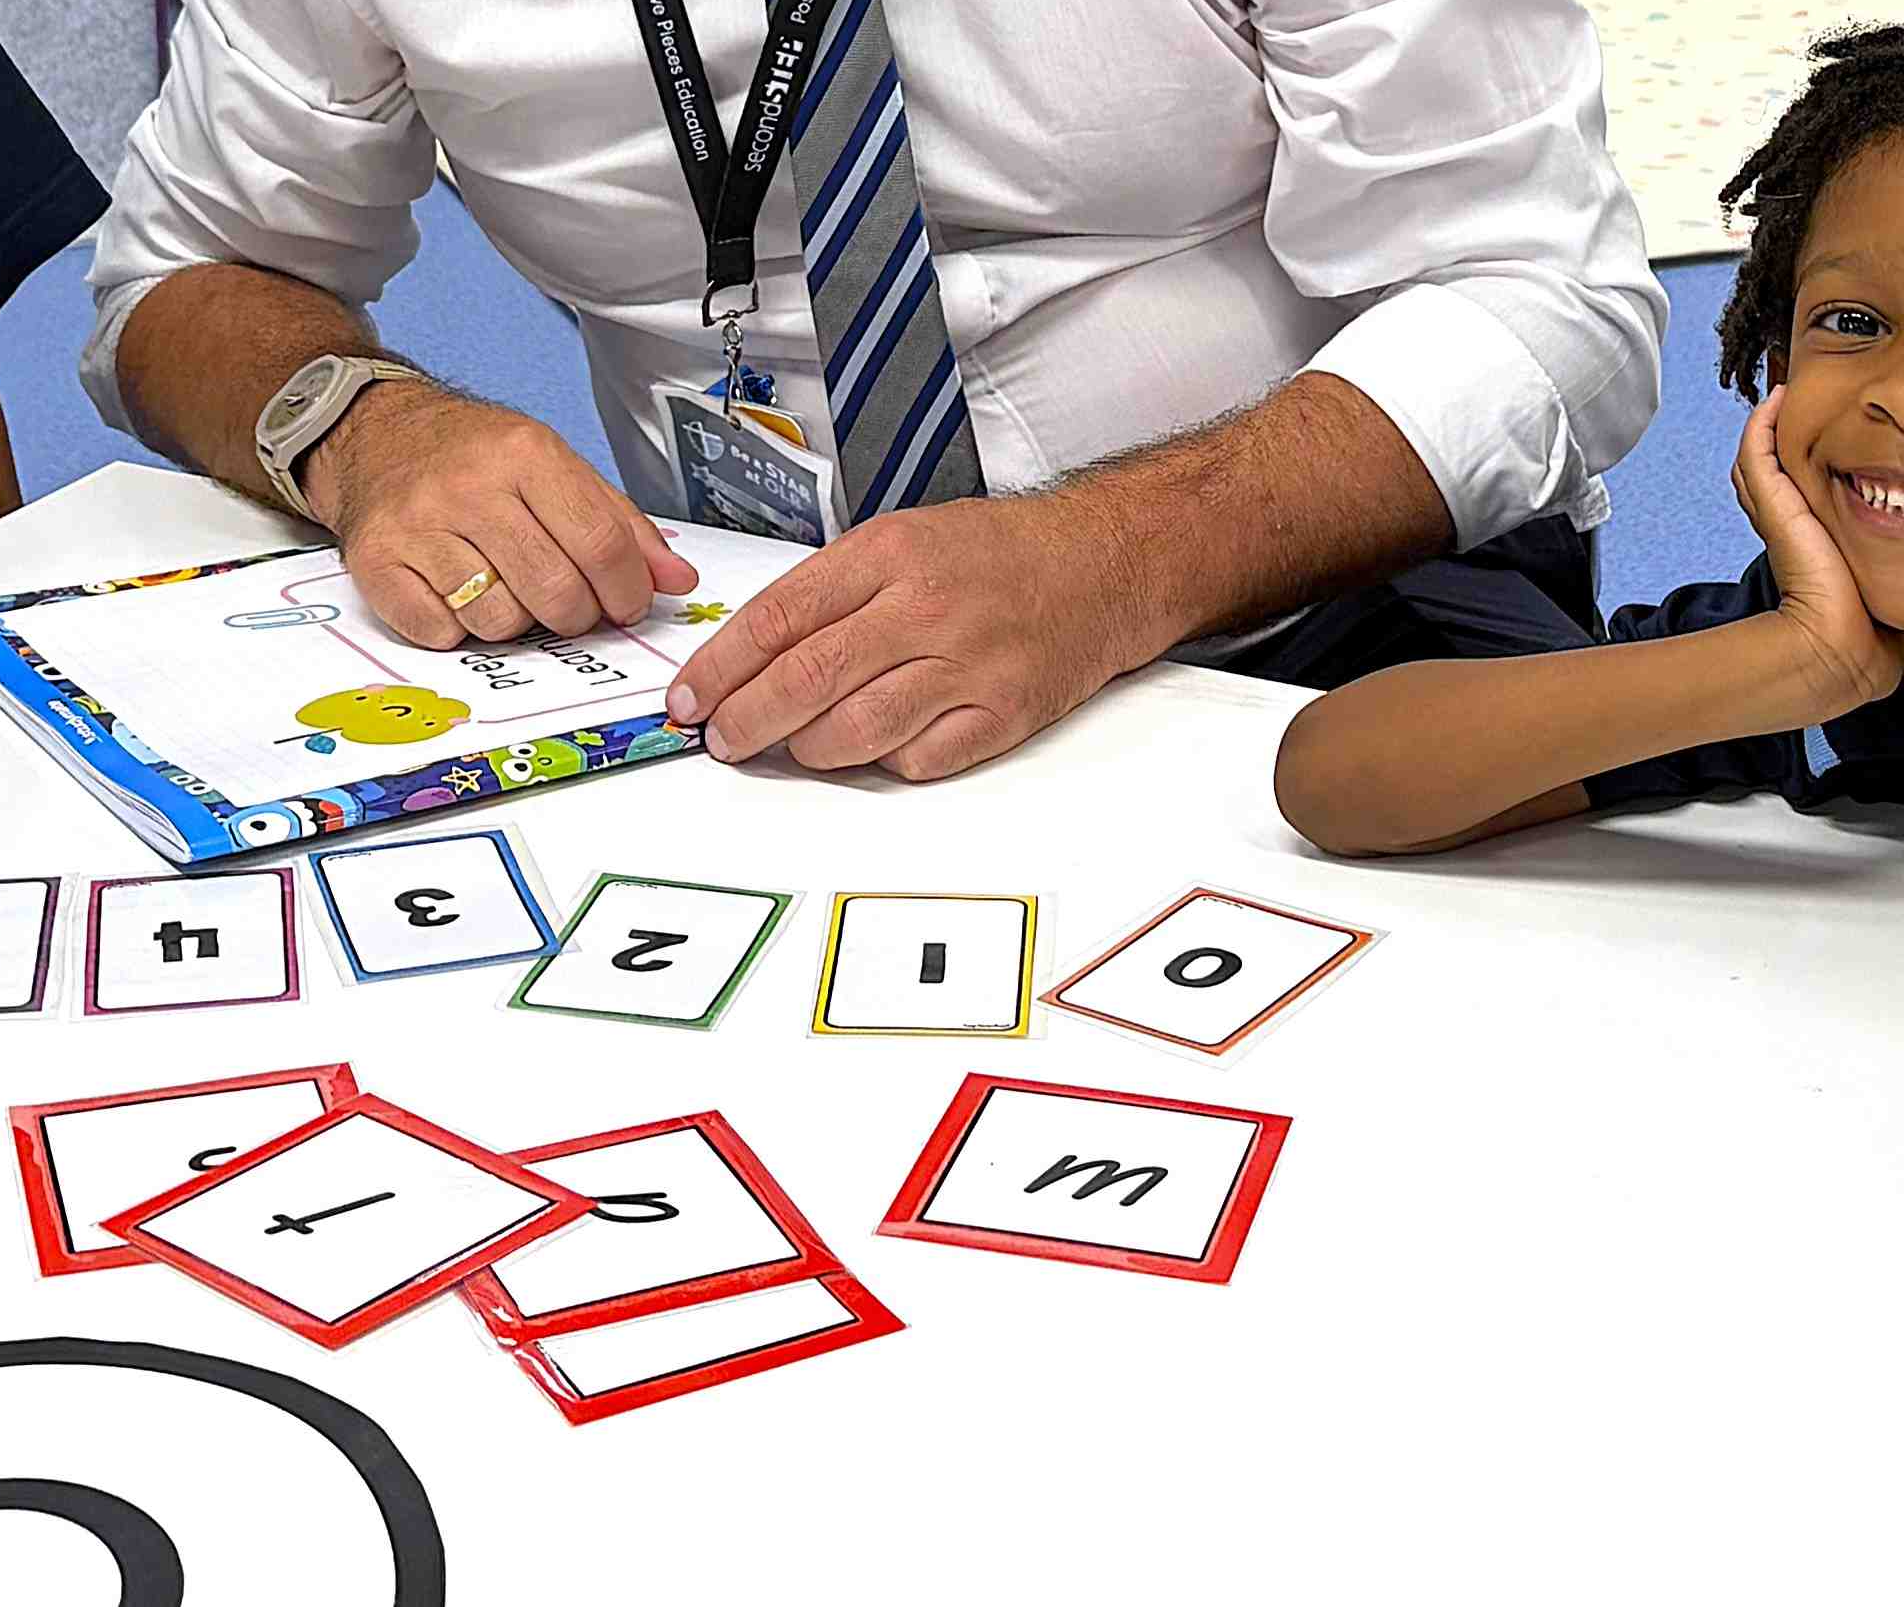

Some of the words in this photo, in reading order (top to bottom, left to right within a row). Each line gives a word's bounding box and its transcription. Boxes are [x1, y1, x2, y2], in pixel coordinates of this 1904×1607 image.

[657, 18, 684, 77] Pieces
[674, 77, 710, 162] Education
[766, 458, 813, 501] STAR
[458, 651, 535, 692] Prep
[394, 888, 460, 927] 3
[153, 923, 221, 963] 4
[611, 929, 690, 972] 2
